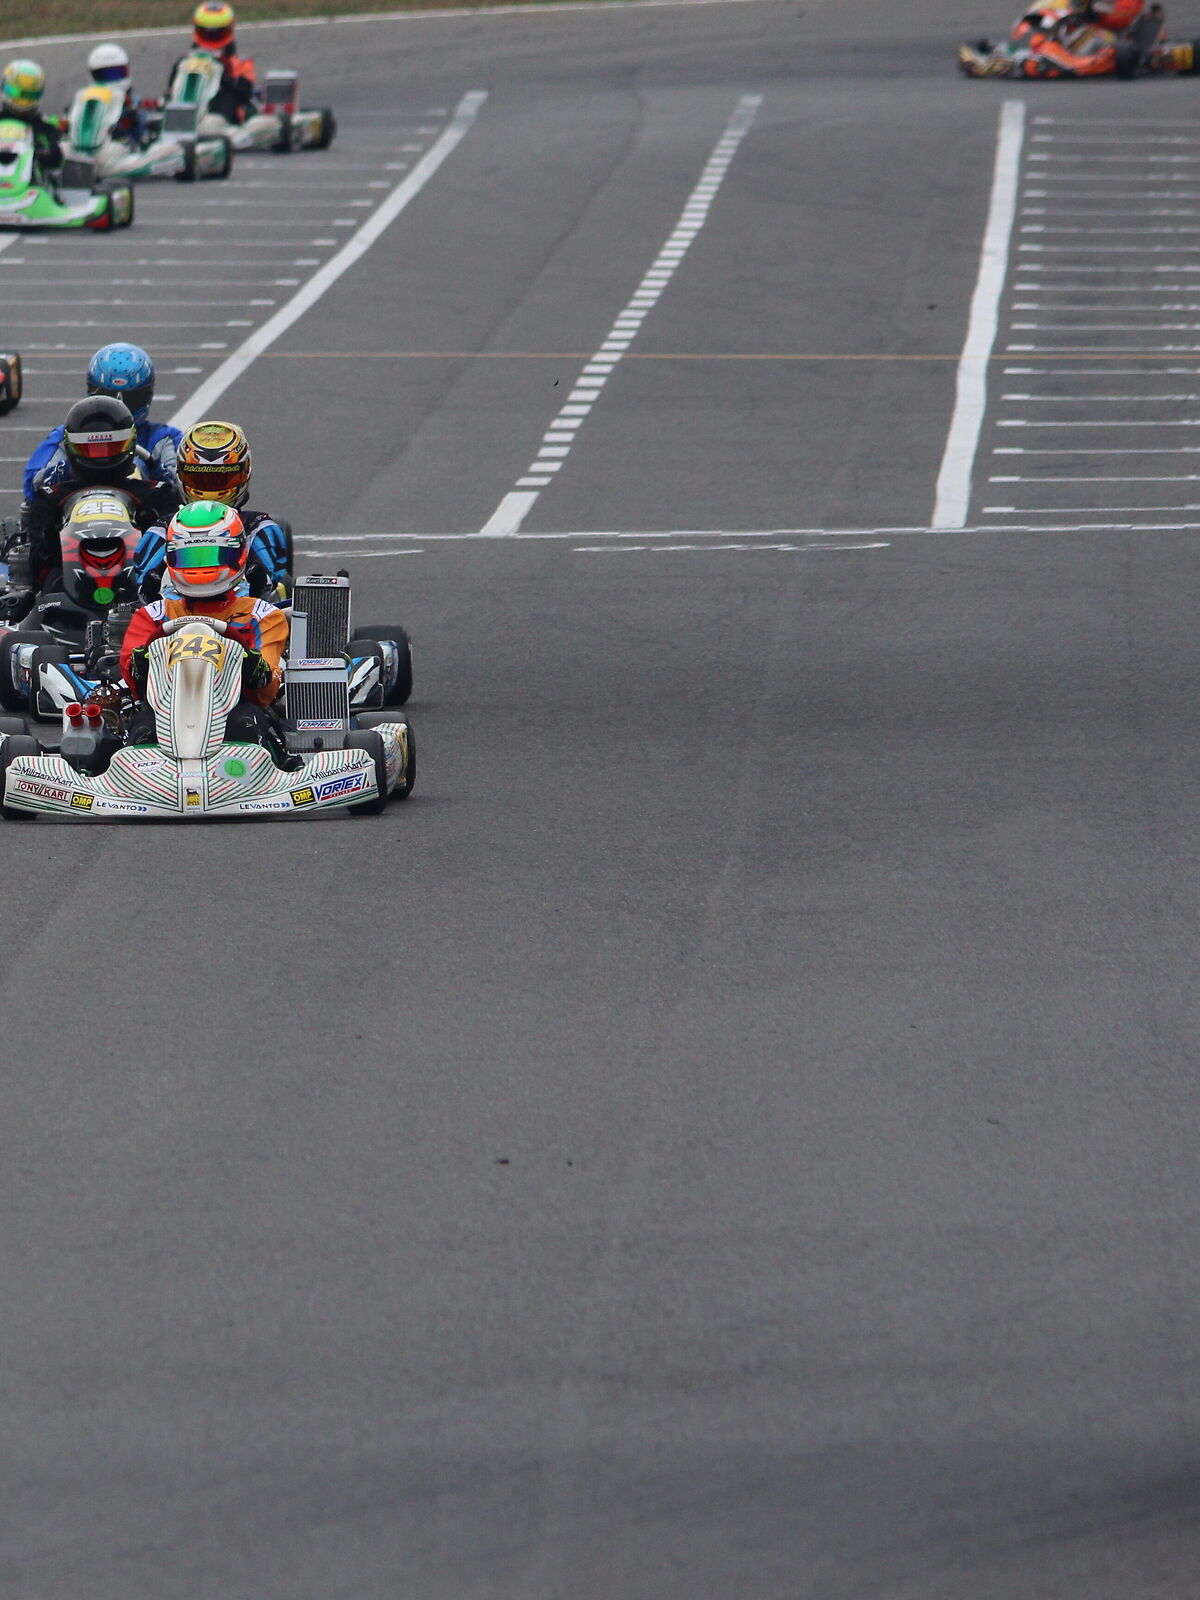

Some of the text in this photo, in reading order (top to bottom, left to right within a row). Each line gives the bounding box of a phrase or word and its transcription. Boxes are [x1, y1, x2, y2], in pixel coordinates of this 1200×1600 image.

[77, 501, 124, 517] 42
[169, 636, 222, 664] 242
[20, 767, 73, 787] MilizianoKart
[310, 761, 363, 781] MilizianoKart
[293, 790, 313, 801] OMP
[314, 773, 363, 801] VORTEX
[72, 796, 93, 807] OMP
[96, 801, 137, 811] LEVANTO
